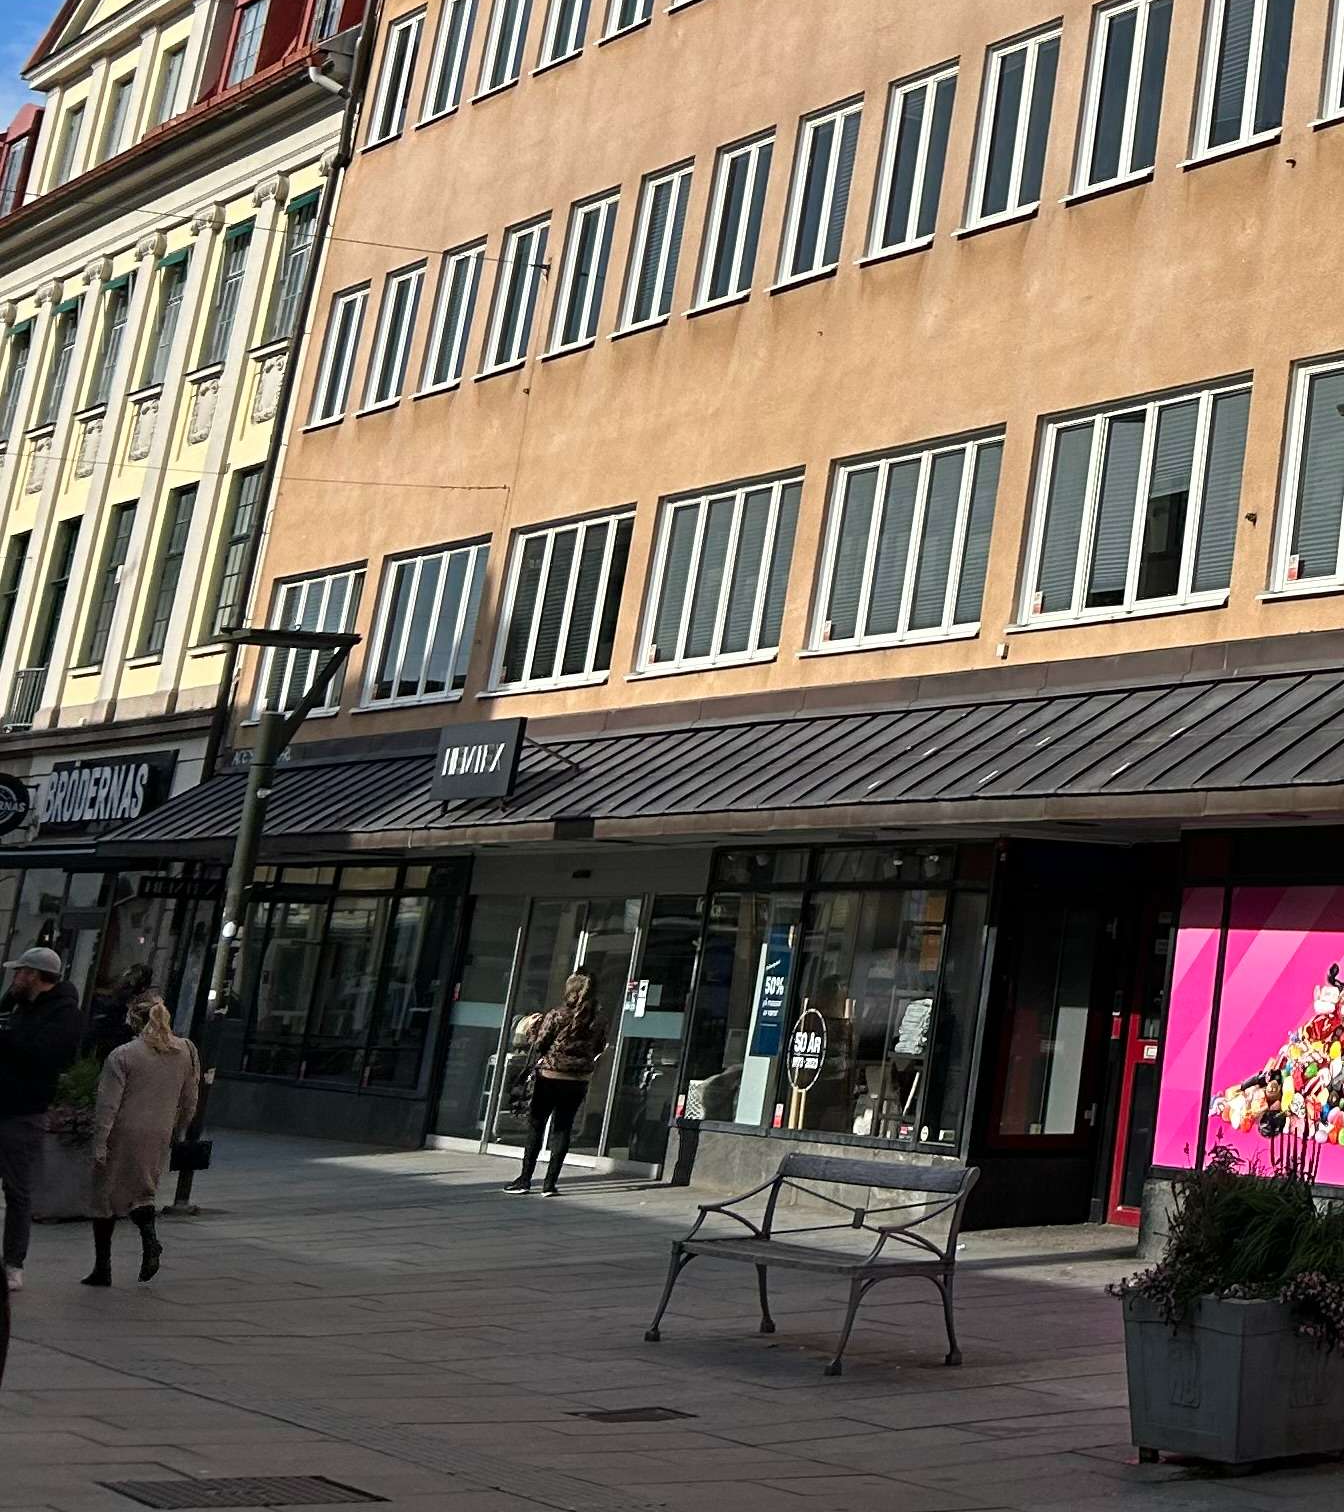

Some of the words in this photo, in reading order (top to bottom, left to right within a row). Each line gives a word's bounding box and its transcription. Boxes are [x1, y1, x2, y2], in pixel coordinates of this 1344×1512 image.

[40, 760, 149, 824] BRÖDERNAS
[764, 975, 785, 996] 50%
[793, 1031, 808, 1053] 50
